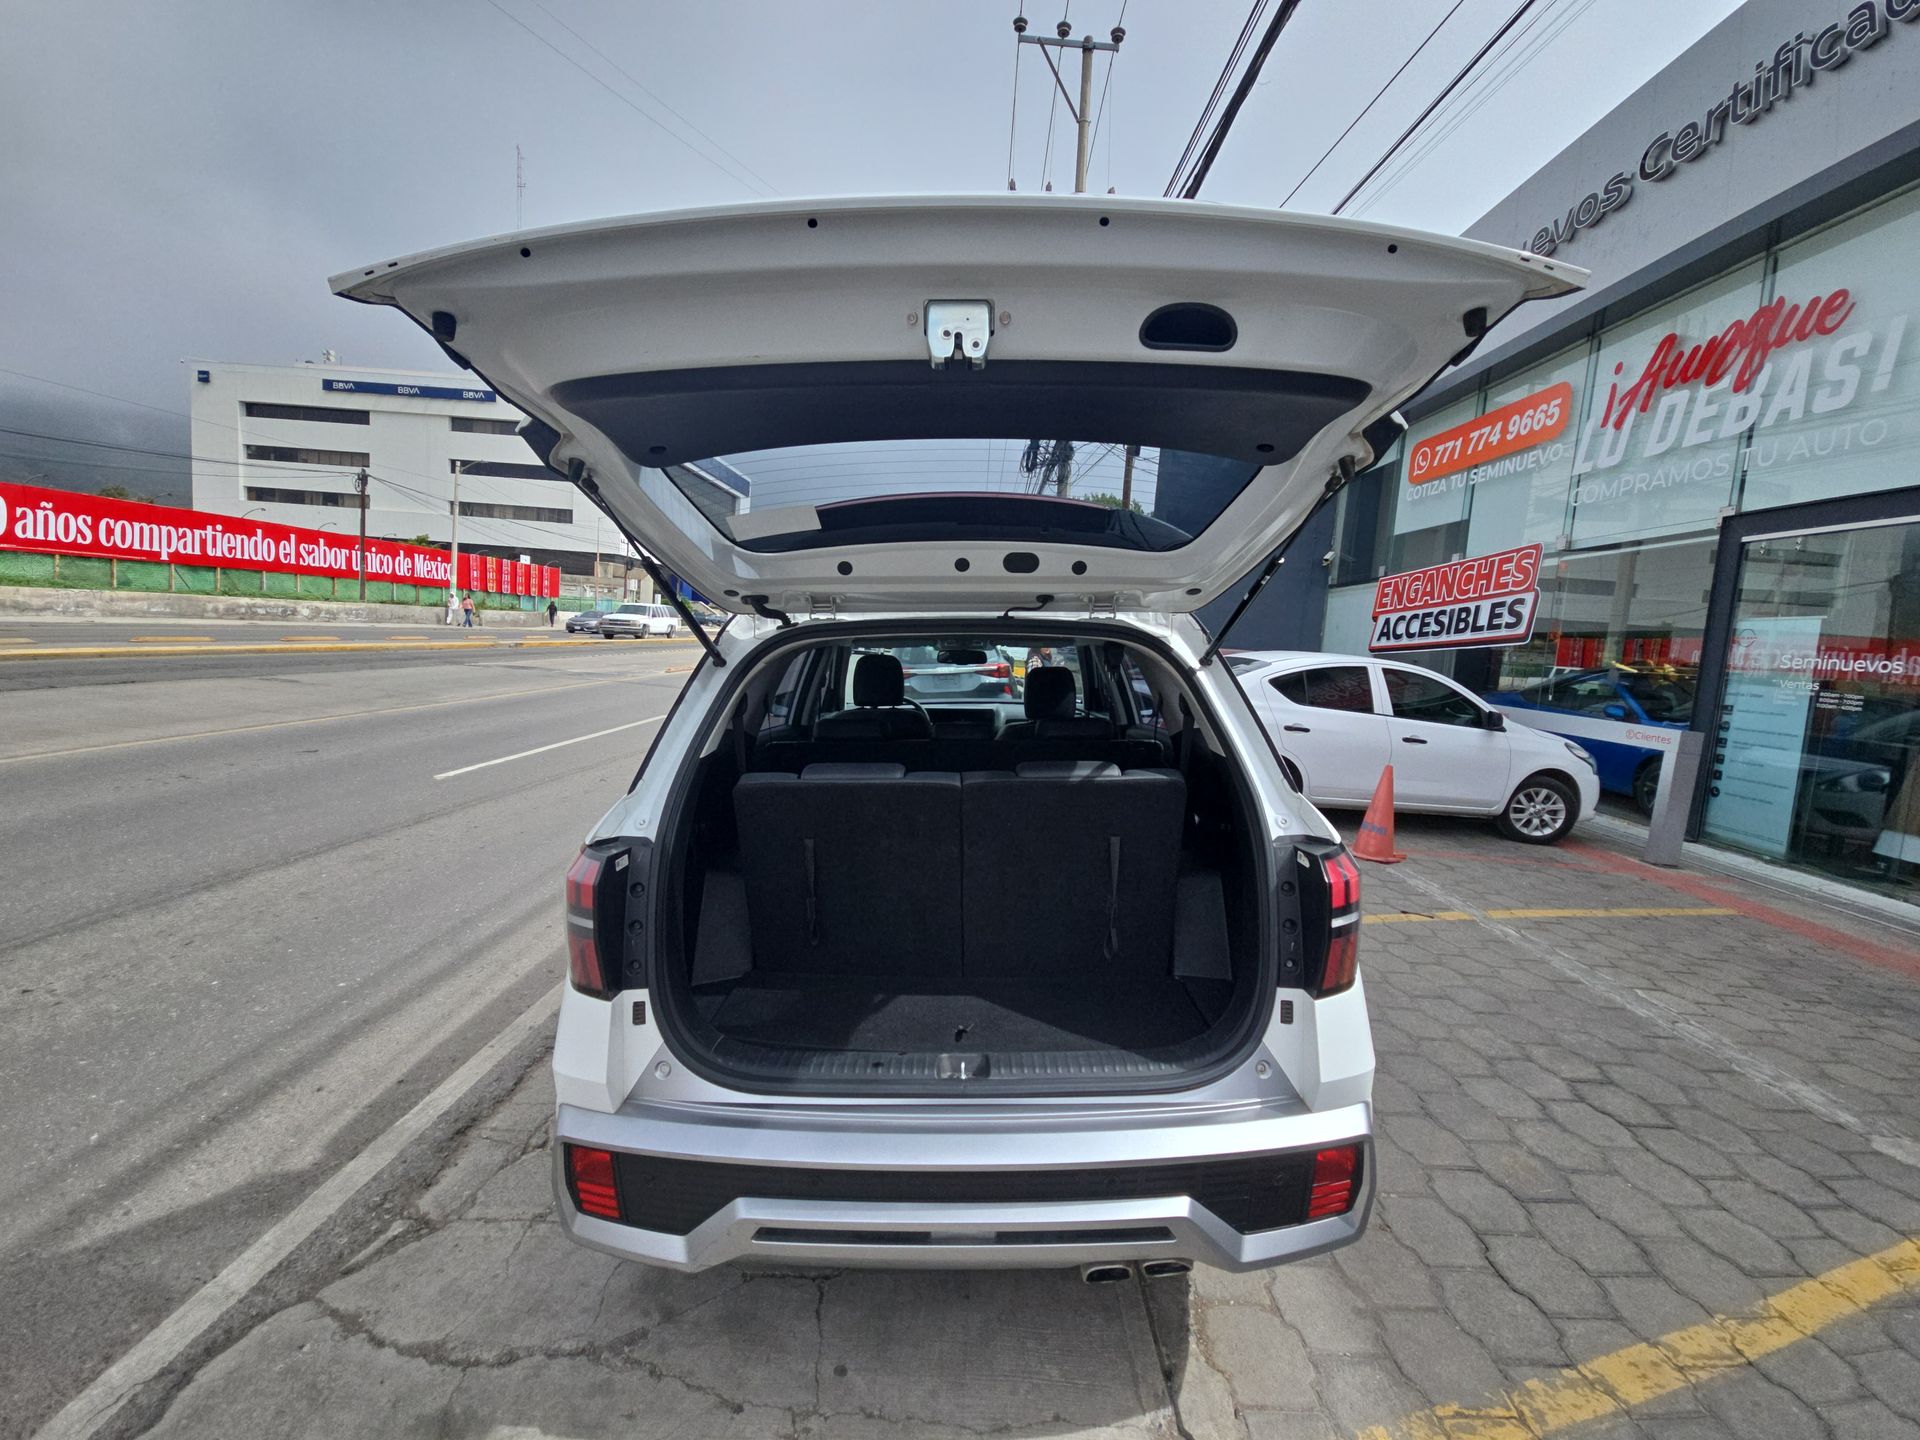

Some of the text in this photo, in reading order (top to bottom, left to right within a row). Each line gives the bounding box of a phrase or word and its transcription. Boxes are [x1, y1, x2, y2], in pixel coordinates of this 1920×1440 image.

[1522, 170, 1634, 257] evos
[333, 381, 355, 390] BBVA
[398, 386, 420, 394] BBVA
[463, 391, 485, 399] BBVA
[1433, 397, 1563, 467] 771 774 9665
[1571, 404, 1637, 475] LO
[1406, 443, 1564, 501] COTIZA TU SEMINUEVO
[1571, 419, 1889, 507] COMPRAMOS TU AUTO
[14, 501, 93, 545] años
[98, 516, 275, 562] compartiendo
[279, 533, 296, 565] el
[299, 538, 350, 570] sabor
[351, 544, 393, 575] único
[394, 550, 412, 576] de
[1375, 549, 1537, 612] ENGANCHES
[1376, 597, 1526, 642] ACCESIBLES
[1779, 655, 1904, 675] Seminuevos
[1779, 680, 1820, 691] Ventas
[1635, 731, 1672, 745] Clientes
